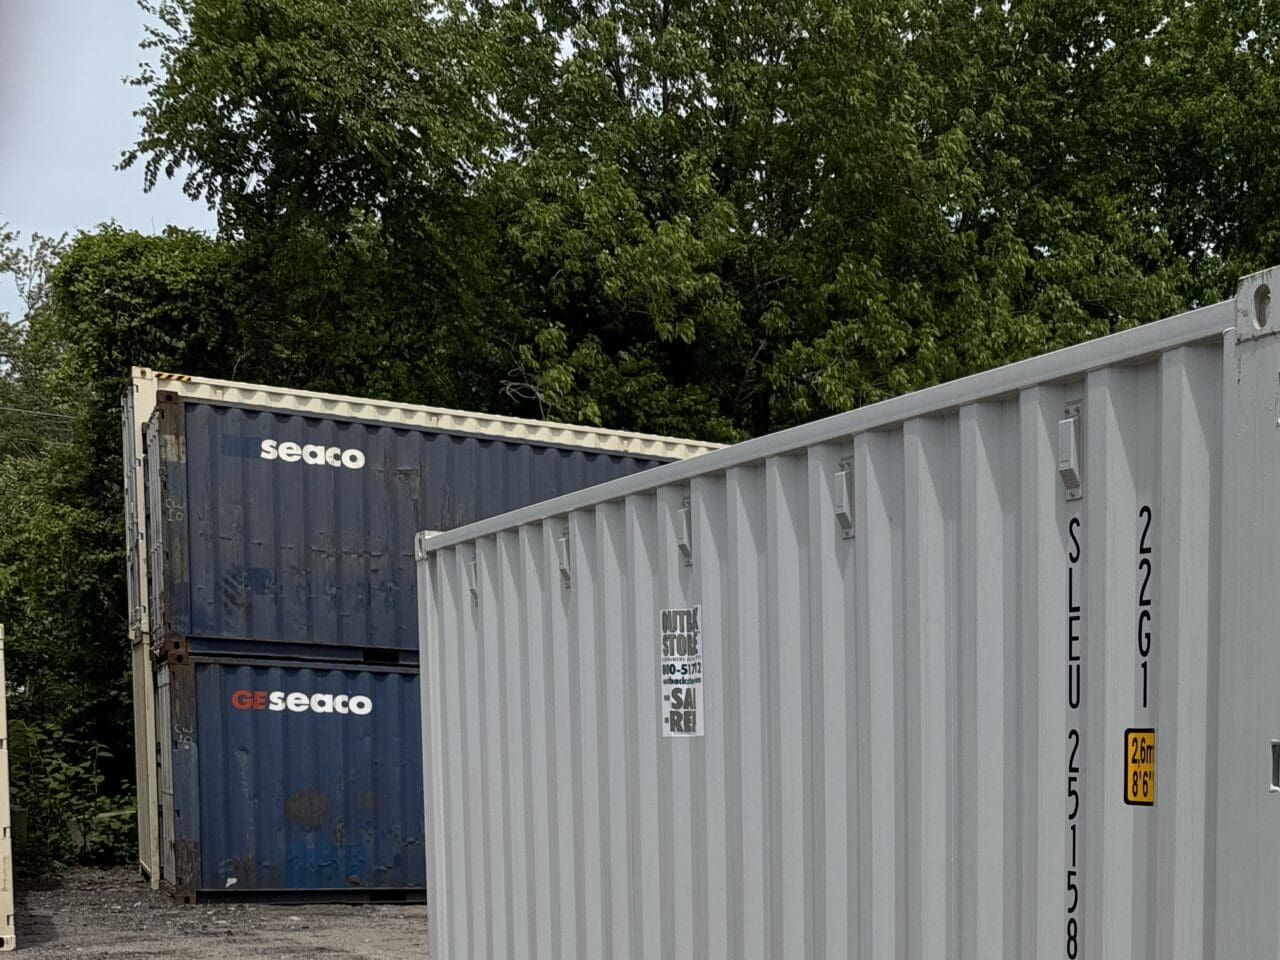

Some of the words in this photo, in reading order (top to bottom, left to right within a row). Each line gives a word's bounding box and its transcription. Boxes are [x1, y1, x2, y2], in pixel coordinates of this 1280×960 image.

[260, 438, 366, 470] seaco
[1068, 517, 1081, 709] SLEU
[1138, 505, 1152, 708] 22G1
[231, 689, 373, 715] GEseaco
